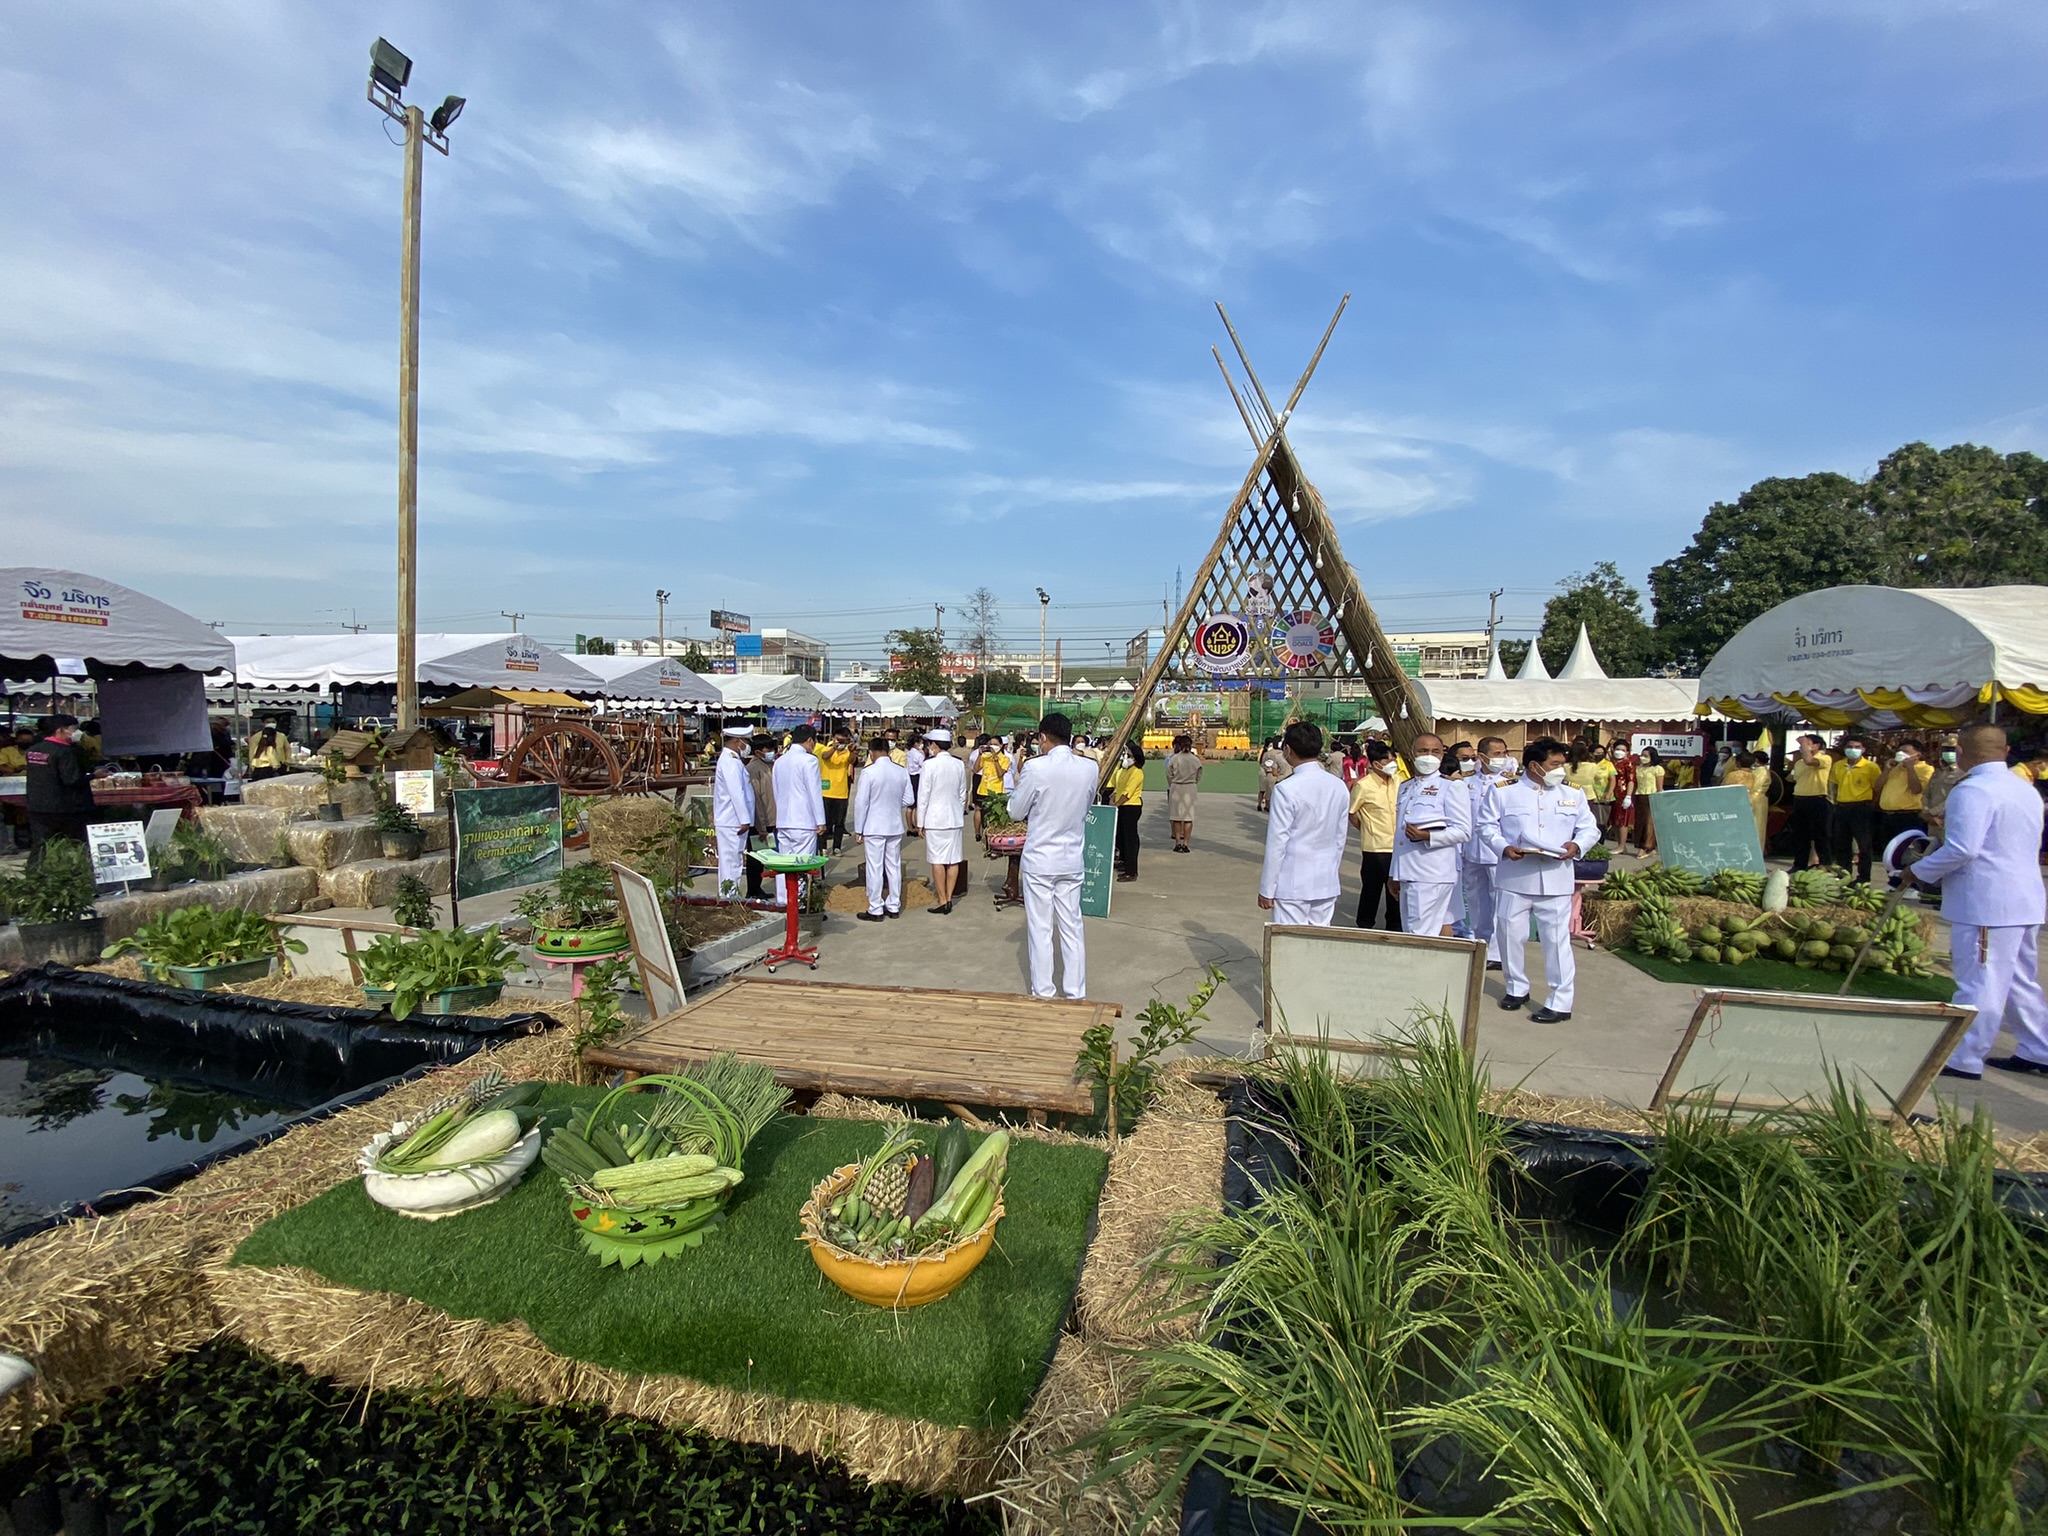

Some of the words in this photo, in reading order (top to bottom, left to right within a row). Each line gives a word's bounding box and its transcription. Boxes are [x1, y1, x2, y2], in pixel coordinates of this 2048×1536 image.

[61, 588, 111, 609] บริการ
[1245, 606, 1258, 615] Soil
[1259, 606, 1274, 616] Day
[1811, 627, 1843, 647] บริการ
[1192, 654, 1251, 673] กรมการพัฒนาชุมชน
[1640, 736, 1694, 749] กาญจนบุรี
[1673, 812, 1690, 824] โคก
